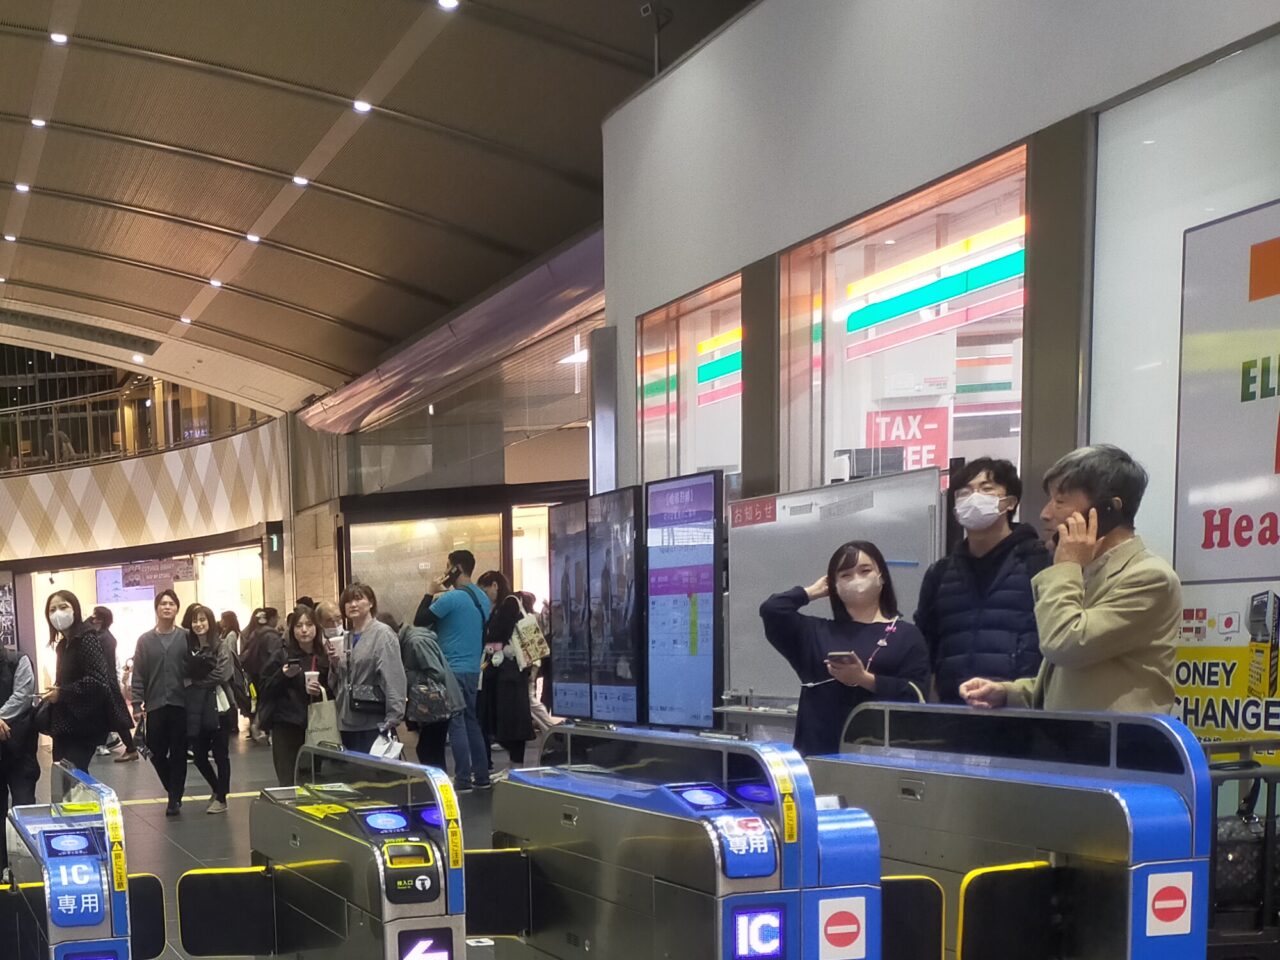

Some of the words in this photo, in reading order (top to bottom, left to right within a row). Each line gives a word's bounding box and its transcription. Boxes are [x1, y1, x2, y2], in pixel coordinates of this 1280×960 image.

[1240, 355, 1280, 403] EL
[876, 415, 938, 442] TAX-
[733, 503, 775, 524] お知らせ
[1175, 661, 1237, 687] ONEY
[729, 835, 768, 854] 専用
[60, 864, 90, 886] IC
[57, 893, 99, 915] 専用
[738, 914, 780, 955] IC
